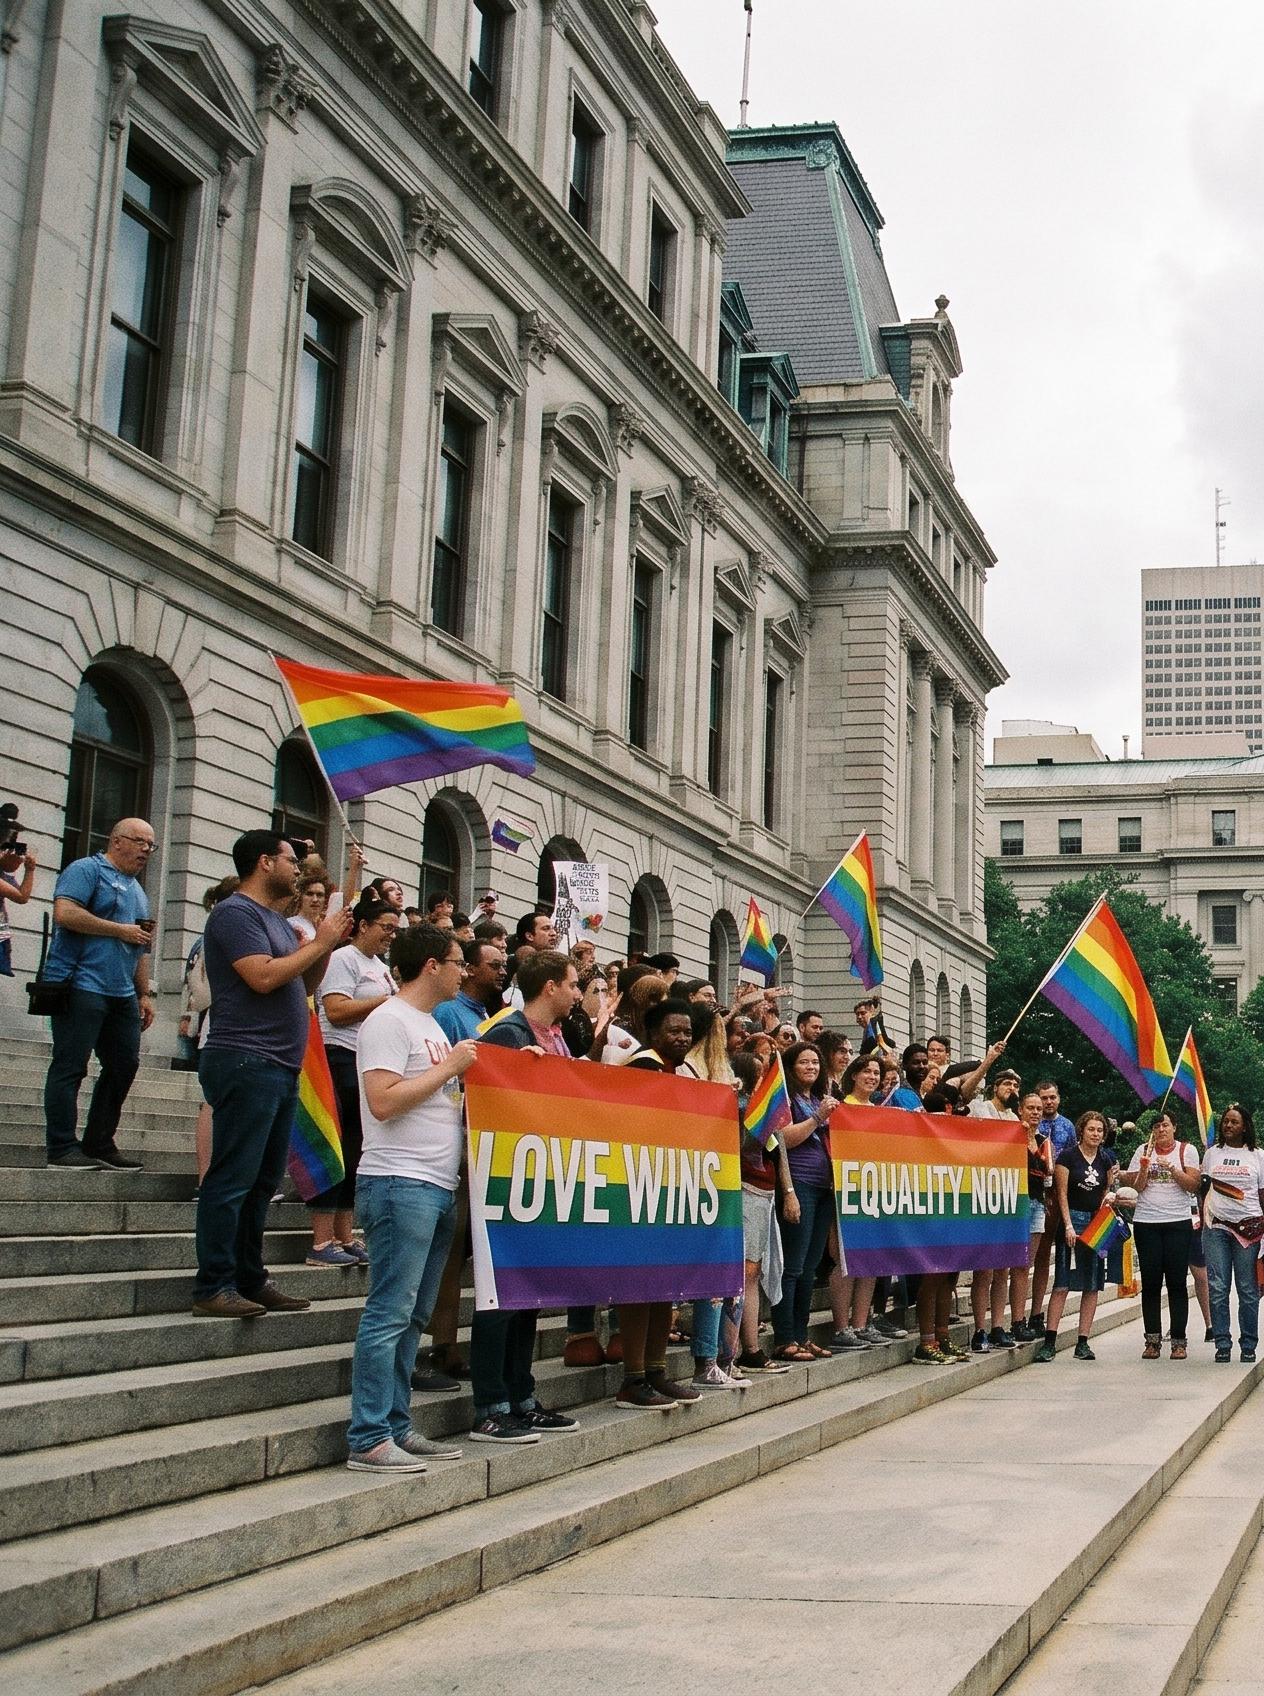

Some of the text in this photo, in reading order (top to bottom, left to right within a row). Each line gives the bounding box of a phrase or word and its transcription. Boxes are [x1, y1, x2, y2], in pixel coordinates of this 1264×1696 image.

[475, 1131, 721, 1226] LOVE WINS
[841, 1161, 1020, 1218] EQUALITY NOW
